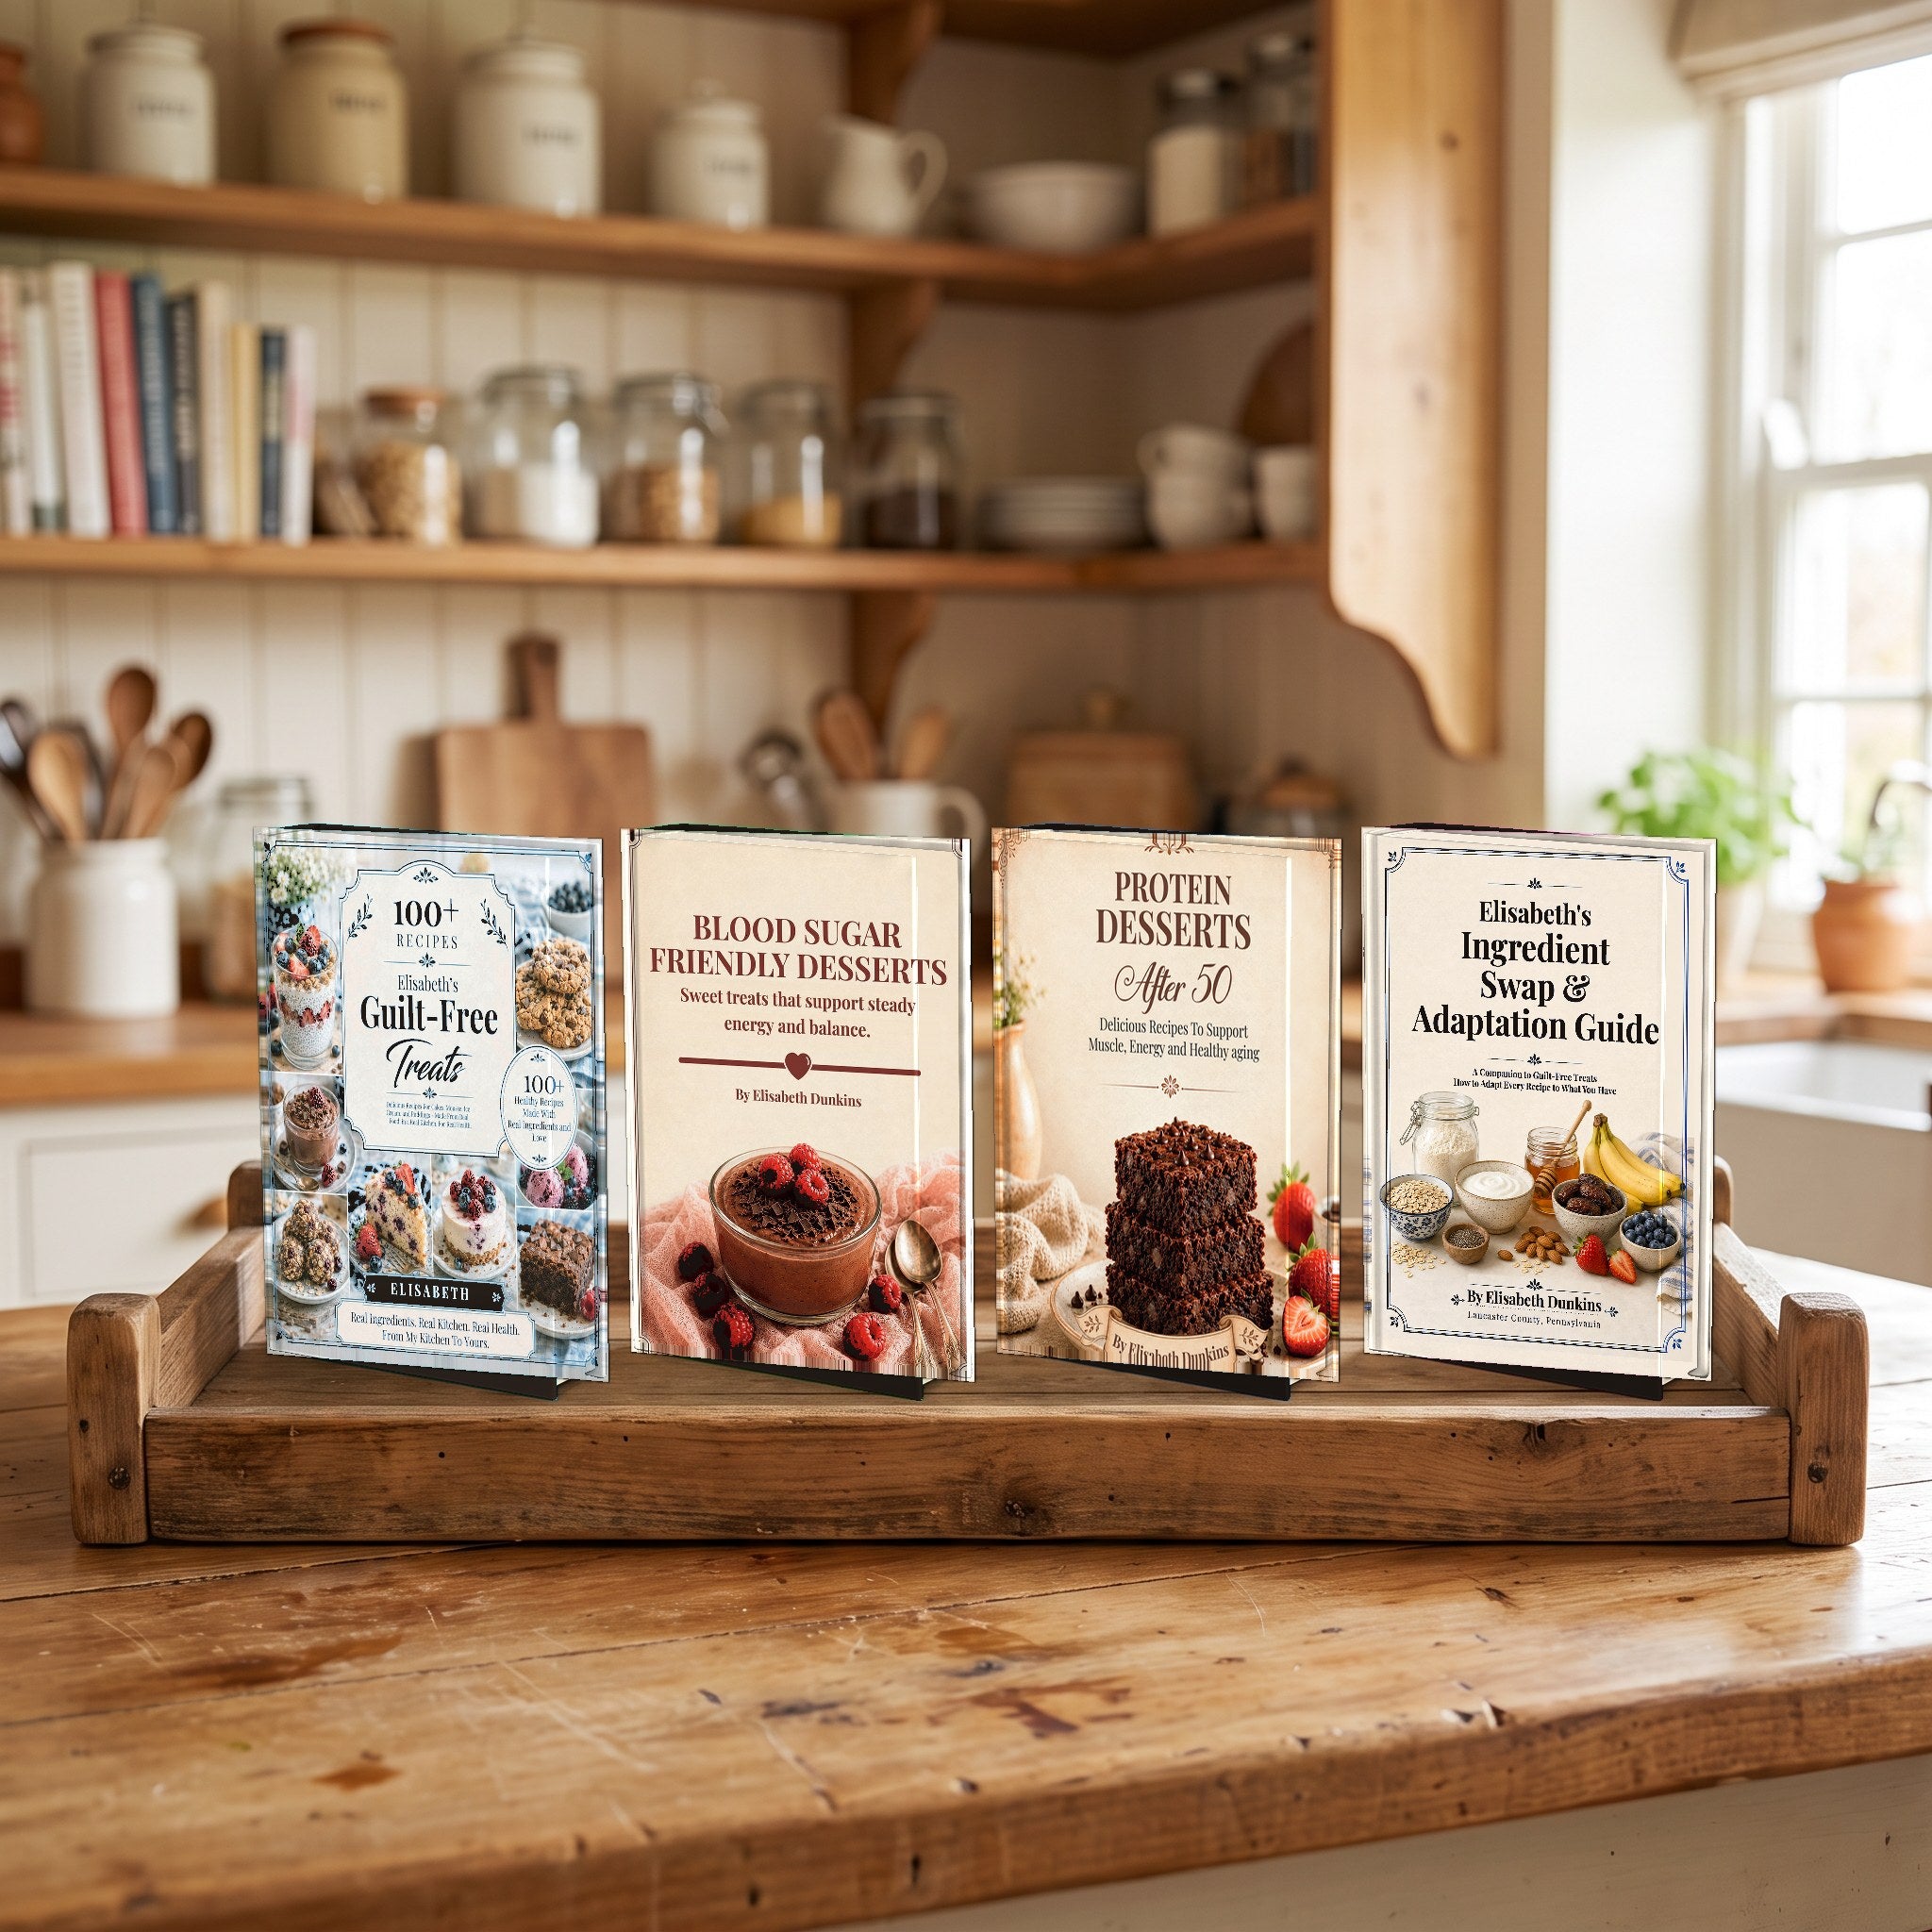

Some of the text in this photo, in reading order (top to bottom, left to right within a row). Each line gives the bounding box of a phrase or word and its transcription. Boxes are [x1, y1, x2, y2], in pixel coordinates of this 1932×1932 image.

[1115, 872, 1231, 905] PROTEIN
[393, 898, 458, 927] 100+
[1479, 900, 1591, 927] Elisabeth's
[693, 915, 902, 948] BLOOD SUGAR
[1096, 909, 1251, 950] DESSERTS
[396, 934, 458, 949] RECIPES
[1461, 931, 1610, 967] Ingredient
[650, 947, 947, 985] FRIENDLY DESSERTS
[1115, 961, 1232, 1014] After 50
[1481, 971, 1591, 1007] Swap &
[680, 988, 916, 1016] Sweet treats that support steady
[360, 995, 497, 1035] Guilt-Free
[1411, 1005, 1659, 1044] Adaptation Guide
[724, 1019, 871, 1038] energy and balance.
[1100, 1017, 1248, 1041] Delicious Recipes To Support
[1089, 1038, 1259, 1063] Muscle, Energy and Healthy aging
[386, 1038, 472, 1088] Treats
[525, 1075, 564, 1094] 100+
[1454, 1078, 1471, 1087] How
[1480, 1080, 1503, 1090] Adapt
[1504, 1081, 1524, 1091] Every
[1526, 1083, 1551, 1091] Recipe
[1598, 1087, 1616, 1095] Have
[1479, 1069, 1522, 1079] Companion
[1533, 1072, 1572, 1081] Guilt-Free
[1574, 1074, 1597, 1083] Treats
[515, 1096, 563, 1108] Healthy Recipes
[735, 1089, 861, 1107] By Elisabeth Dunkins
[541, 1109, 556, 1118] With
[508, 1120, 521, 1128] Real
[559, 1123, 571, 1131] and
[391, 1282, 469, 1300] ELISABETH
[1468, 1290, 1602, 1312] By Elisabeth Dunkins
[351, 1312, 520, 1335] Real Ingredients. Real Kitchen. Real Health.
[1468, 1311, 1601, 1328] Lancaster County, Pennsylvania
[382, 1330, 489, 1348] From My Kitchen To Yours.
[1112, 1333, 1127, 1353] By
